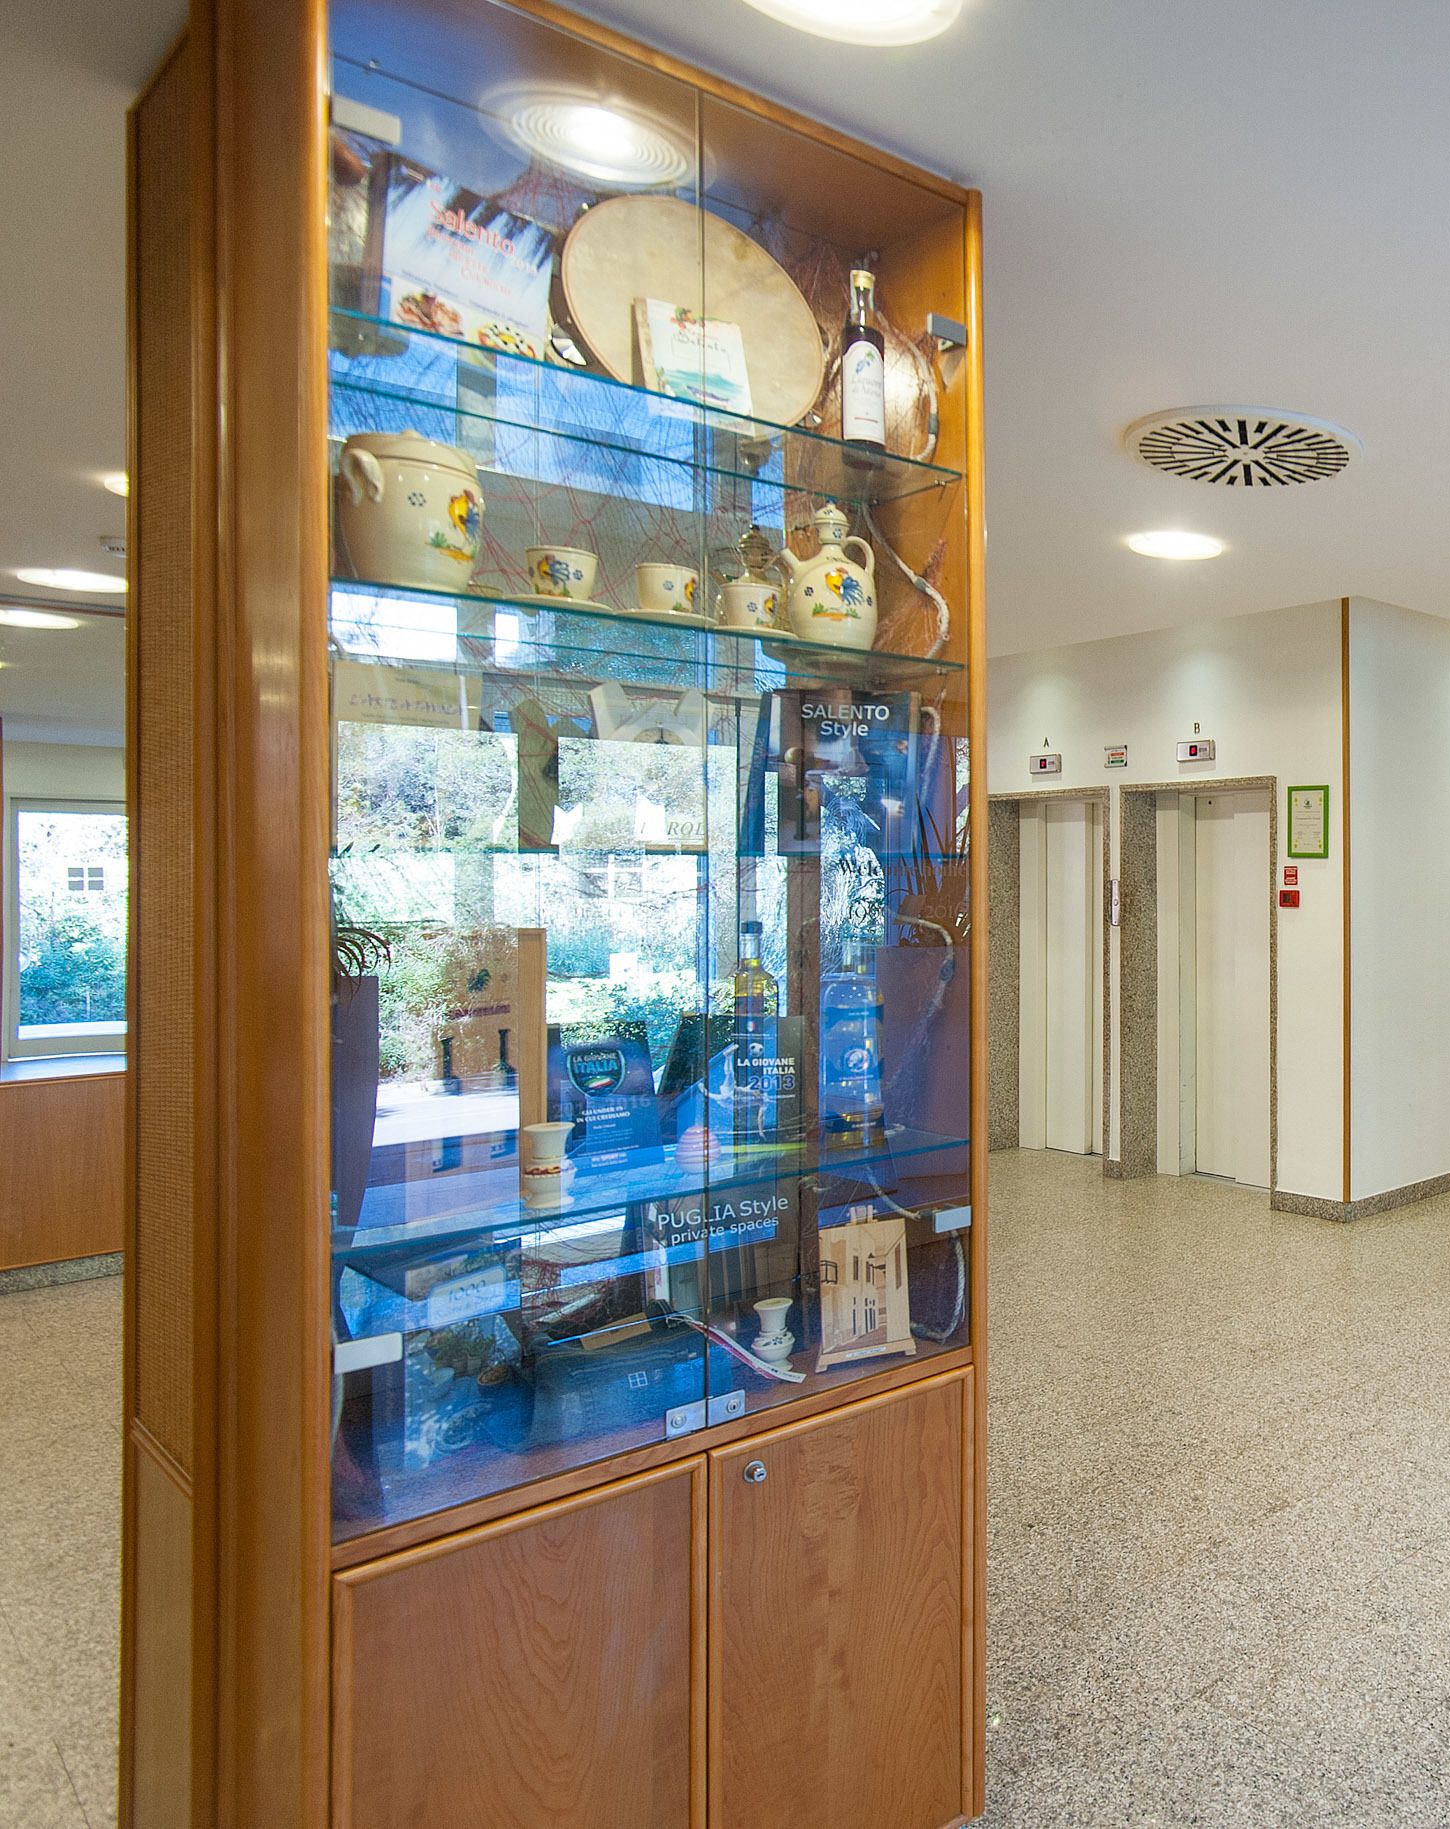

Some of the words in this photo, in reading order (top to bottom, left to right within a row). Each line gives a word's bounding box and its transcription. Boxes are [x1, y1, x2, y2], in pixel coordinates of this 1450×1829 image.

[430, 201, 515, 256] Salento
[801, 704, 890, 720] SALENTO
[820, 721, 869, 740] Style
[1193, 722, 1200, 734] B
[1043, 737, 1049, 748] A
[574, 1059, 618, 1073] ITALIA
[737, 1058, 750, 1067] LA
[752, 1057, 796, 1066] GIOVANE
[763, 1066, 796, 1075] ITALIA
[748, 1075, 796, 1092] 2013
[740, 1195, 789, 1216] Style
[671, 1225, 724, 1246] private
[730, 1216, 780, 1235] spaces
